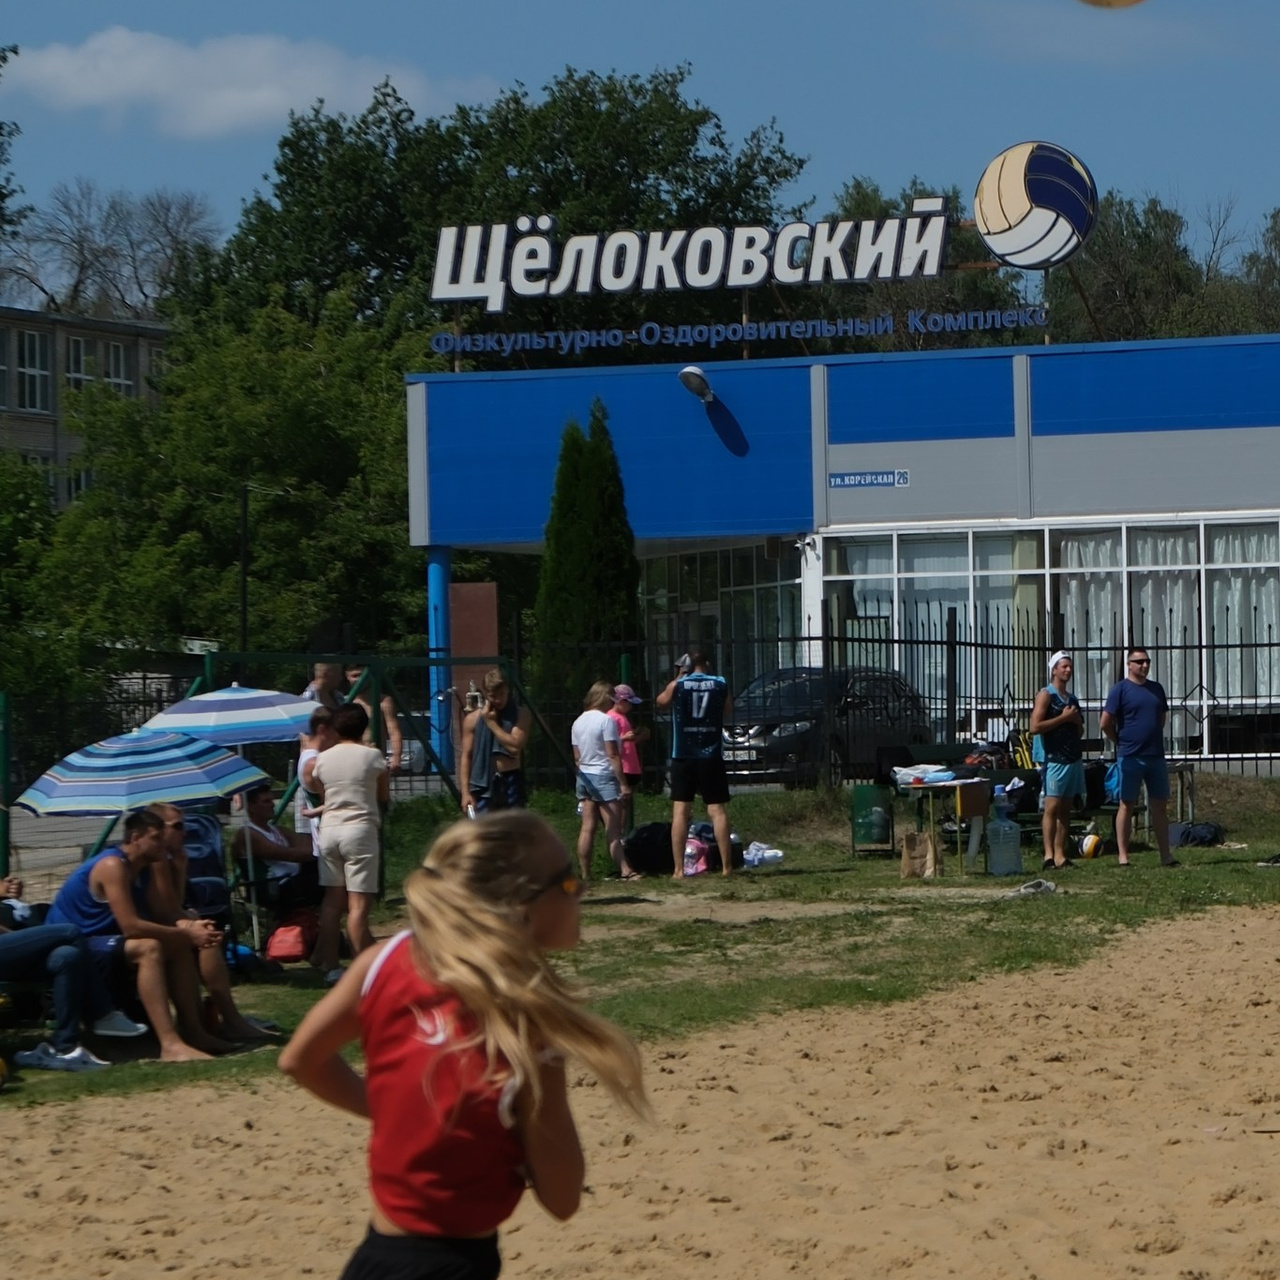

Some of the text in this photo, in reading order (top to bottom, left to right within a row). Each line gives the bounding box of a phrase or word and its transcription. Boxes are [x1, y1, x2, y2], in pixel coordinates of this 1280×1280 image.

[431, 308, 1049, 356] Физкультурно-Оздоровительный Комплекс
[692, 691, 709, 718] 17
